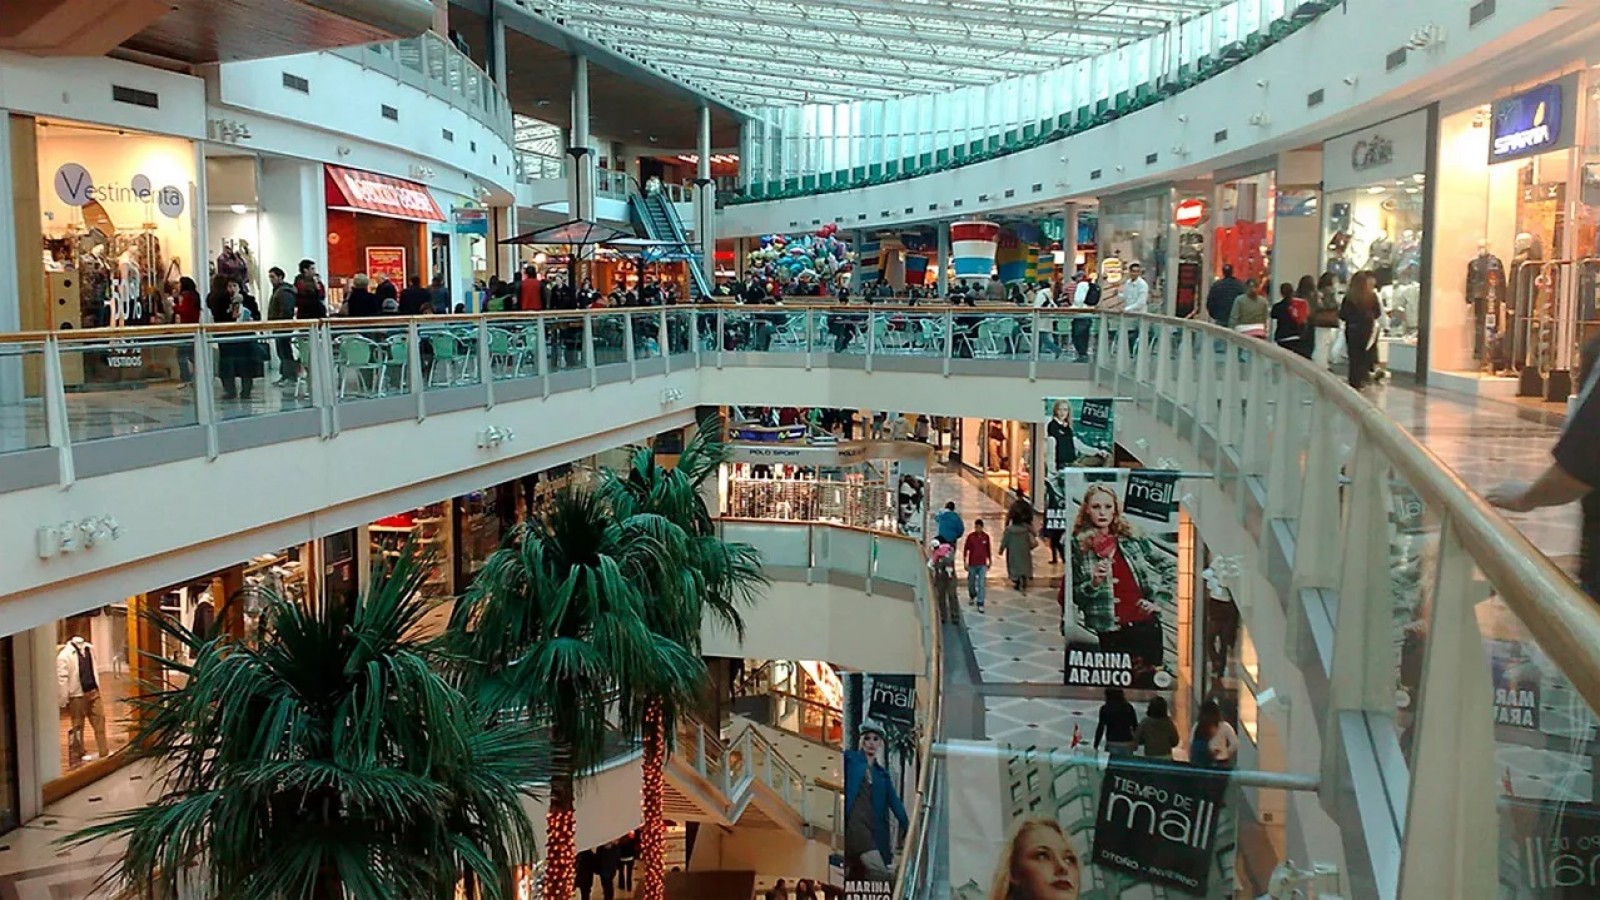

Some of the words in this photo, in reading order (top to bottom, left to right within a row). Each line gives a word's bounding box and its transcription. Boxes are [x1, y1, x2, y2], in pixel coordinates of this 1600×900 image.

[1494, 125, 1549, 155] SPARTA
[61, 170, 180, 206] Vestimenta
[750, 449, 771, 457] POLO
[773, 449, 801, 458] SPORT
[1128, 482, 1173, 504] mall
[1069, 650, 1132, 669] MARINA
[1069, 667, 1132, 686] ARAUCO
[874, 688, 916, 709] mall
[1113, 775, 1168, 803] TIEMPO
[1173, 793, 1194, 812] DE
[1107, 791, 1214, 850] mall
[845, 880, 891, 894] MARINA
